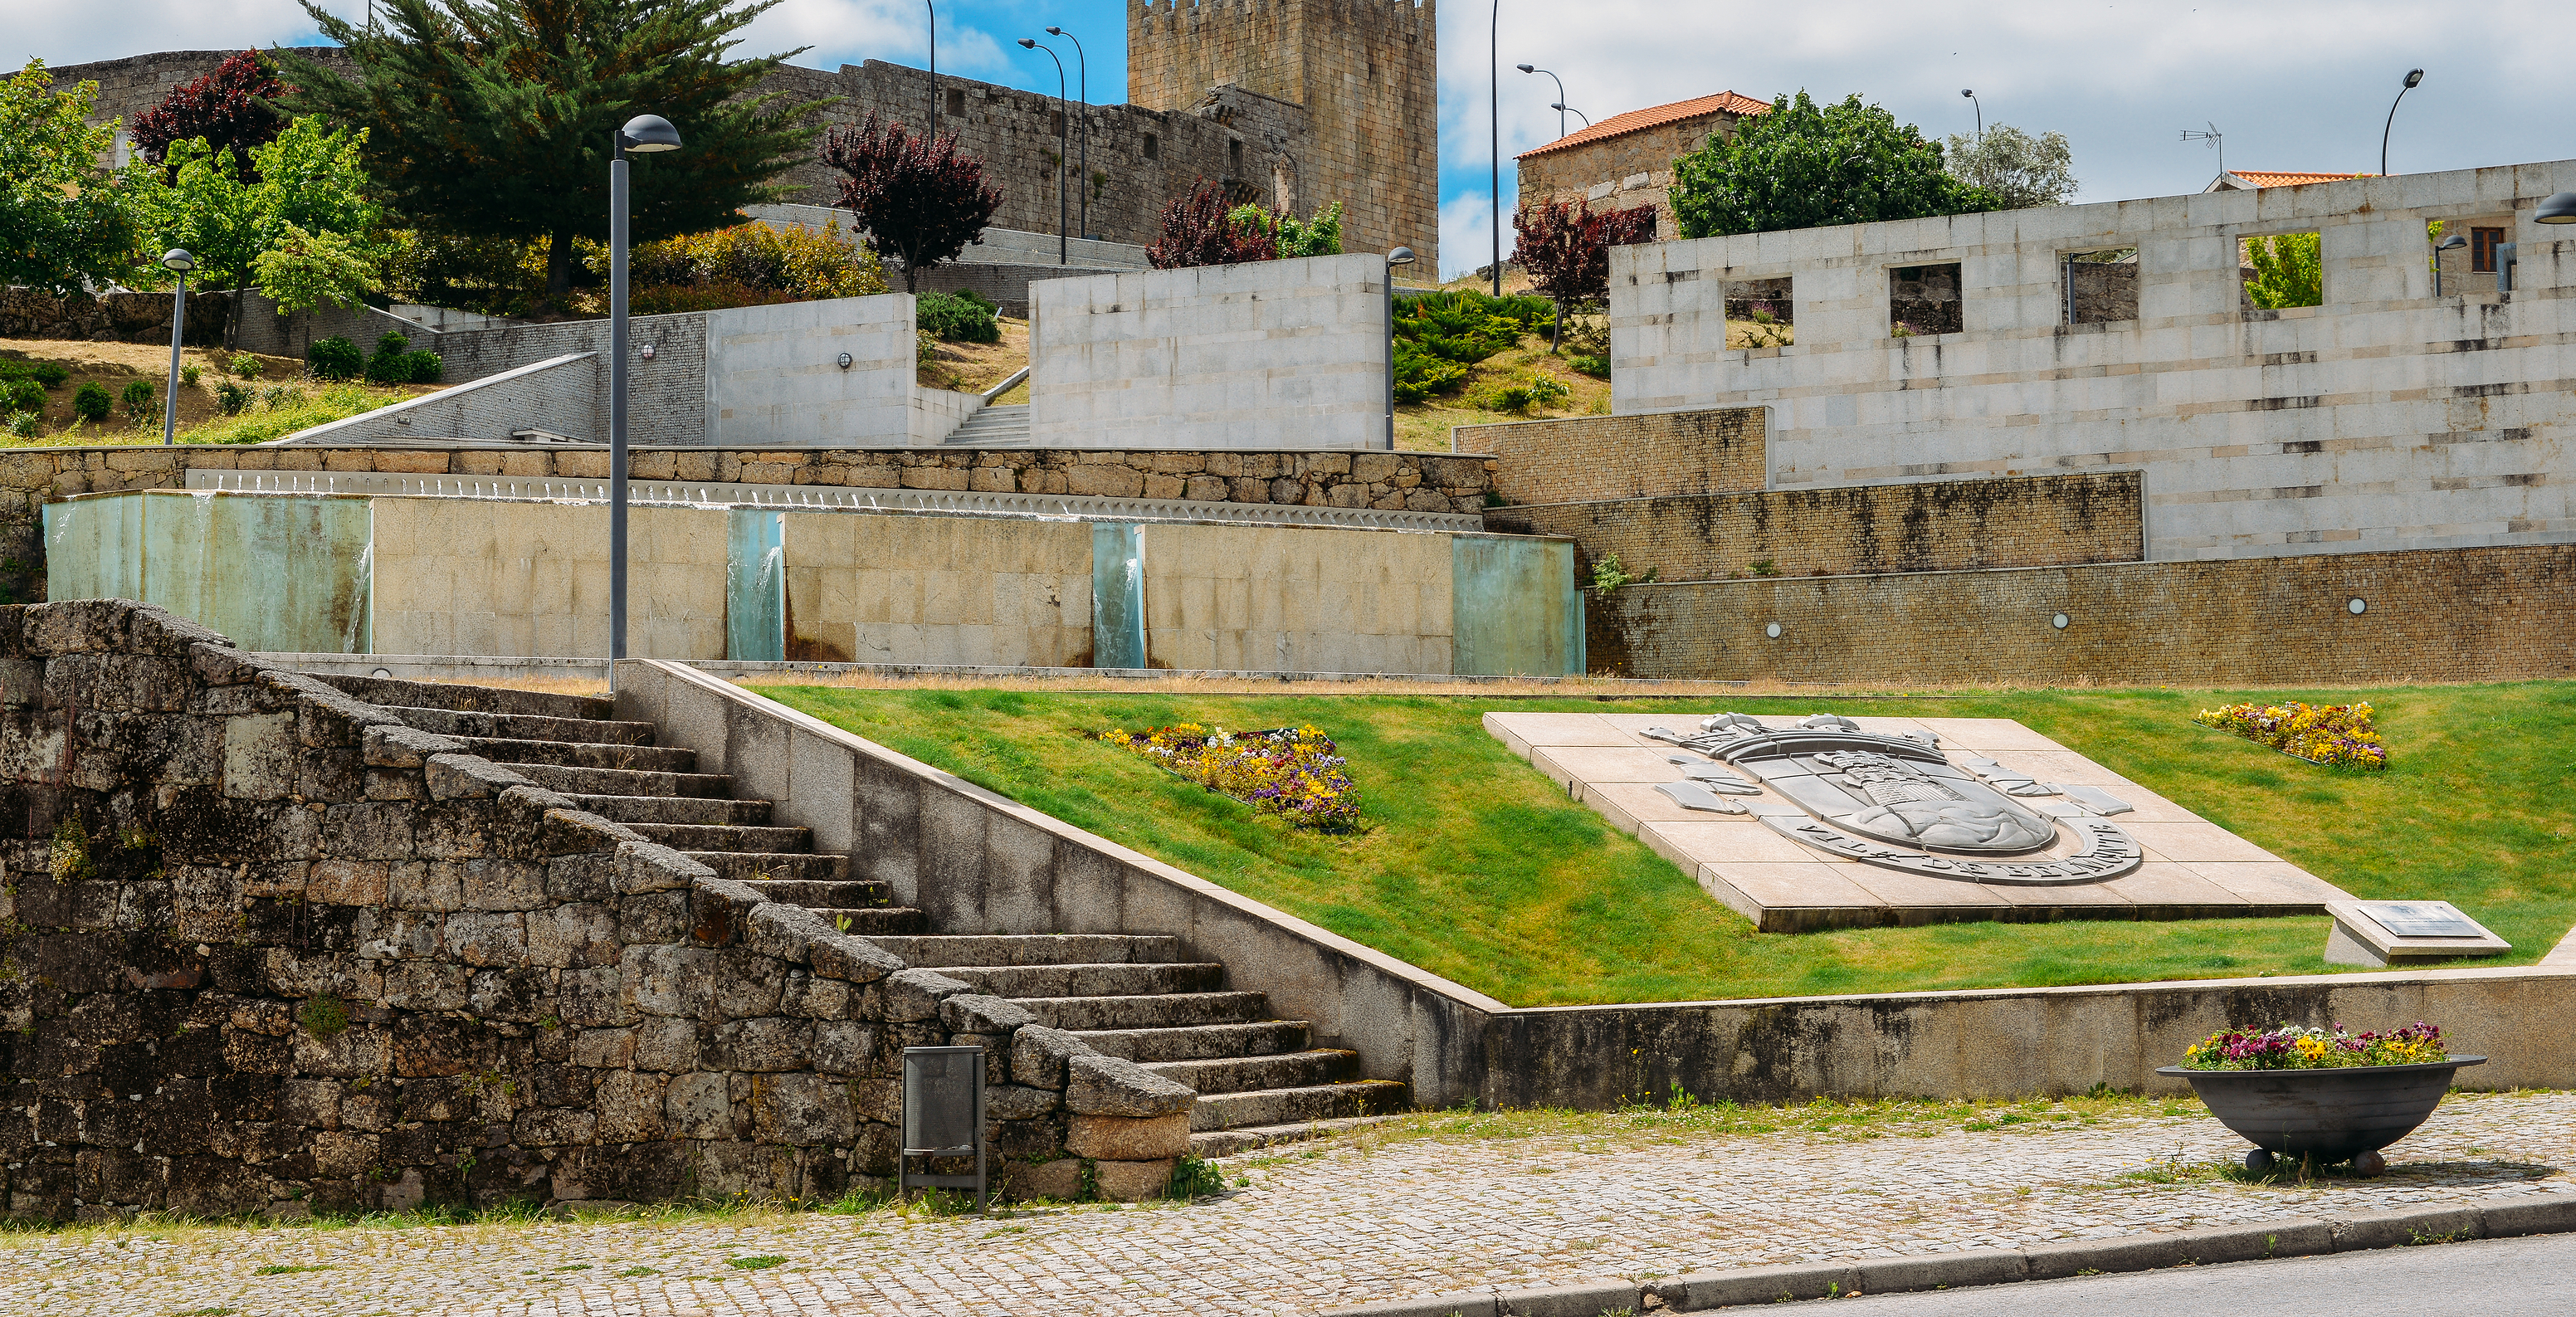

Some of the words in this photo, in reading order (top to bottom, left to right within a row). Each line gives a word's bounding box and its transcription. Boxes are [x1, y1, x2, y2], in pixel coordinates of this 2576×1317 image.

[1797, 825, 1901, 863] VILA
[1921, 856, 1988, 876] DE
[1996, 824, 2129, 878] BELMONTE
